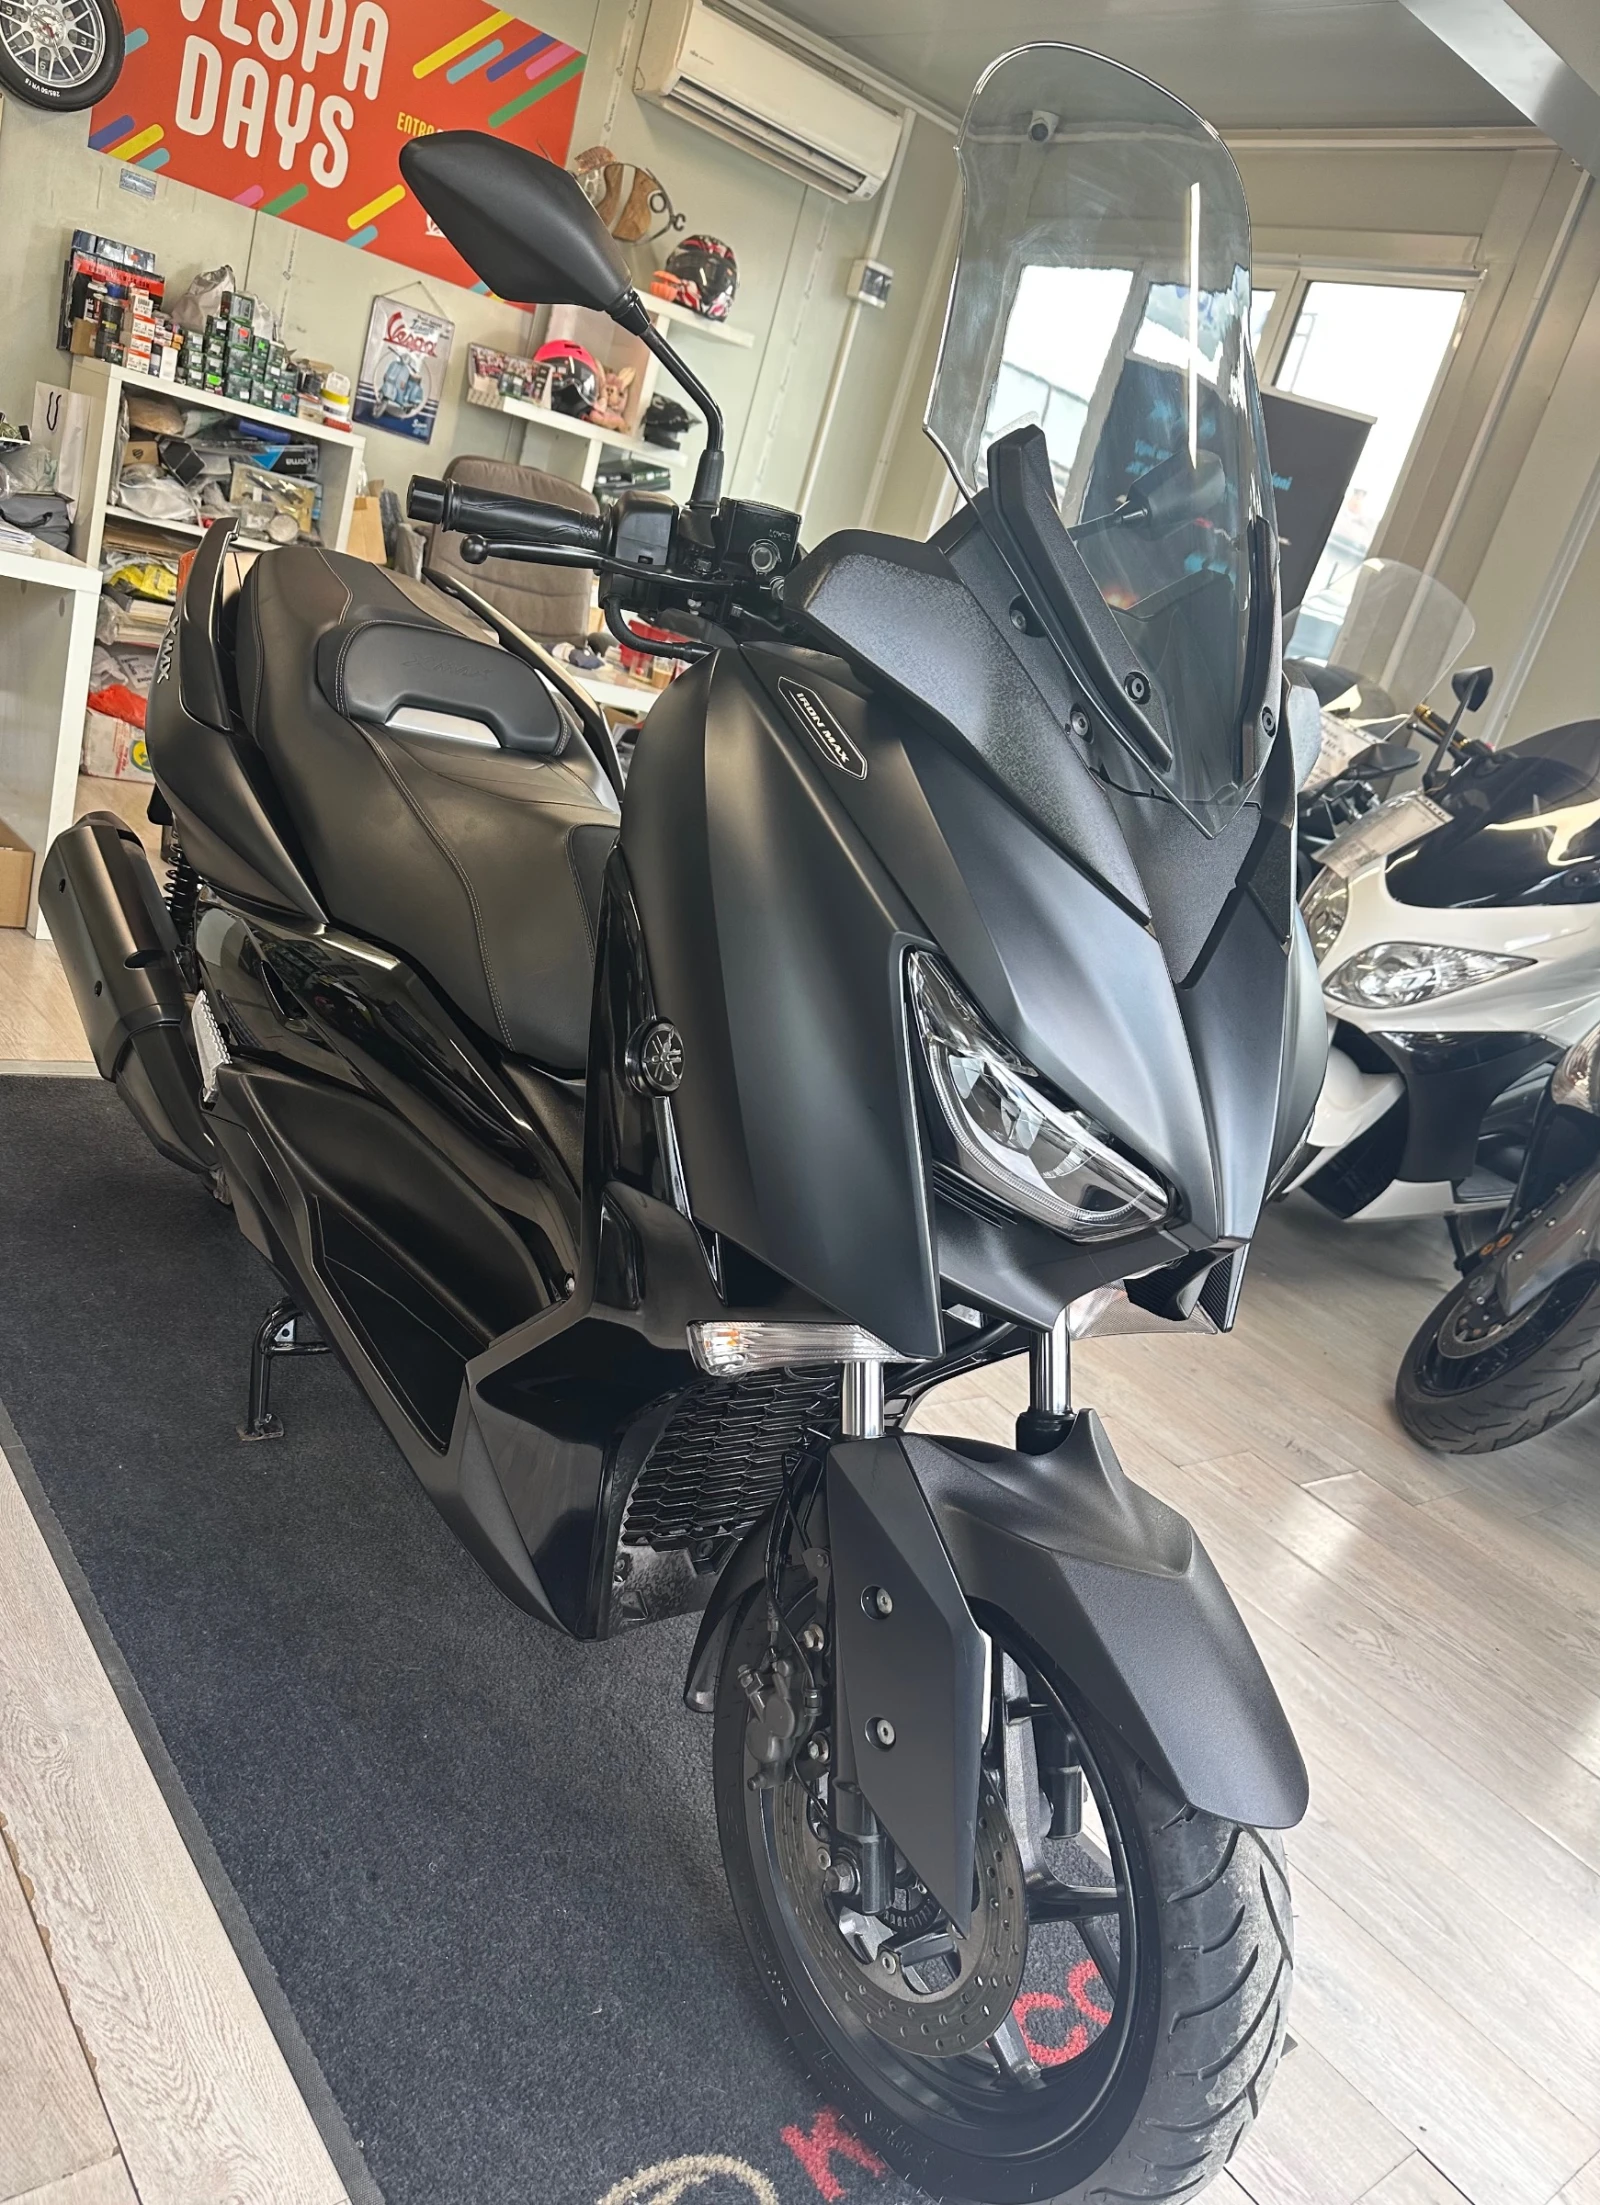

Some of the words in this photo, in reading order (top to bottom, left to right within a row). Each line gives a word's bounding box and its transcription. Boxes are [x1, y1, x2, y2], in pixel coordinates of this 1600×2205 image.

[175, 34, 354, 189] DAYS
[796, 692, 826, 728] IRON
[822, 729, 850, 763] MAX
